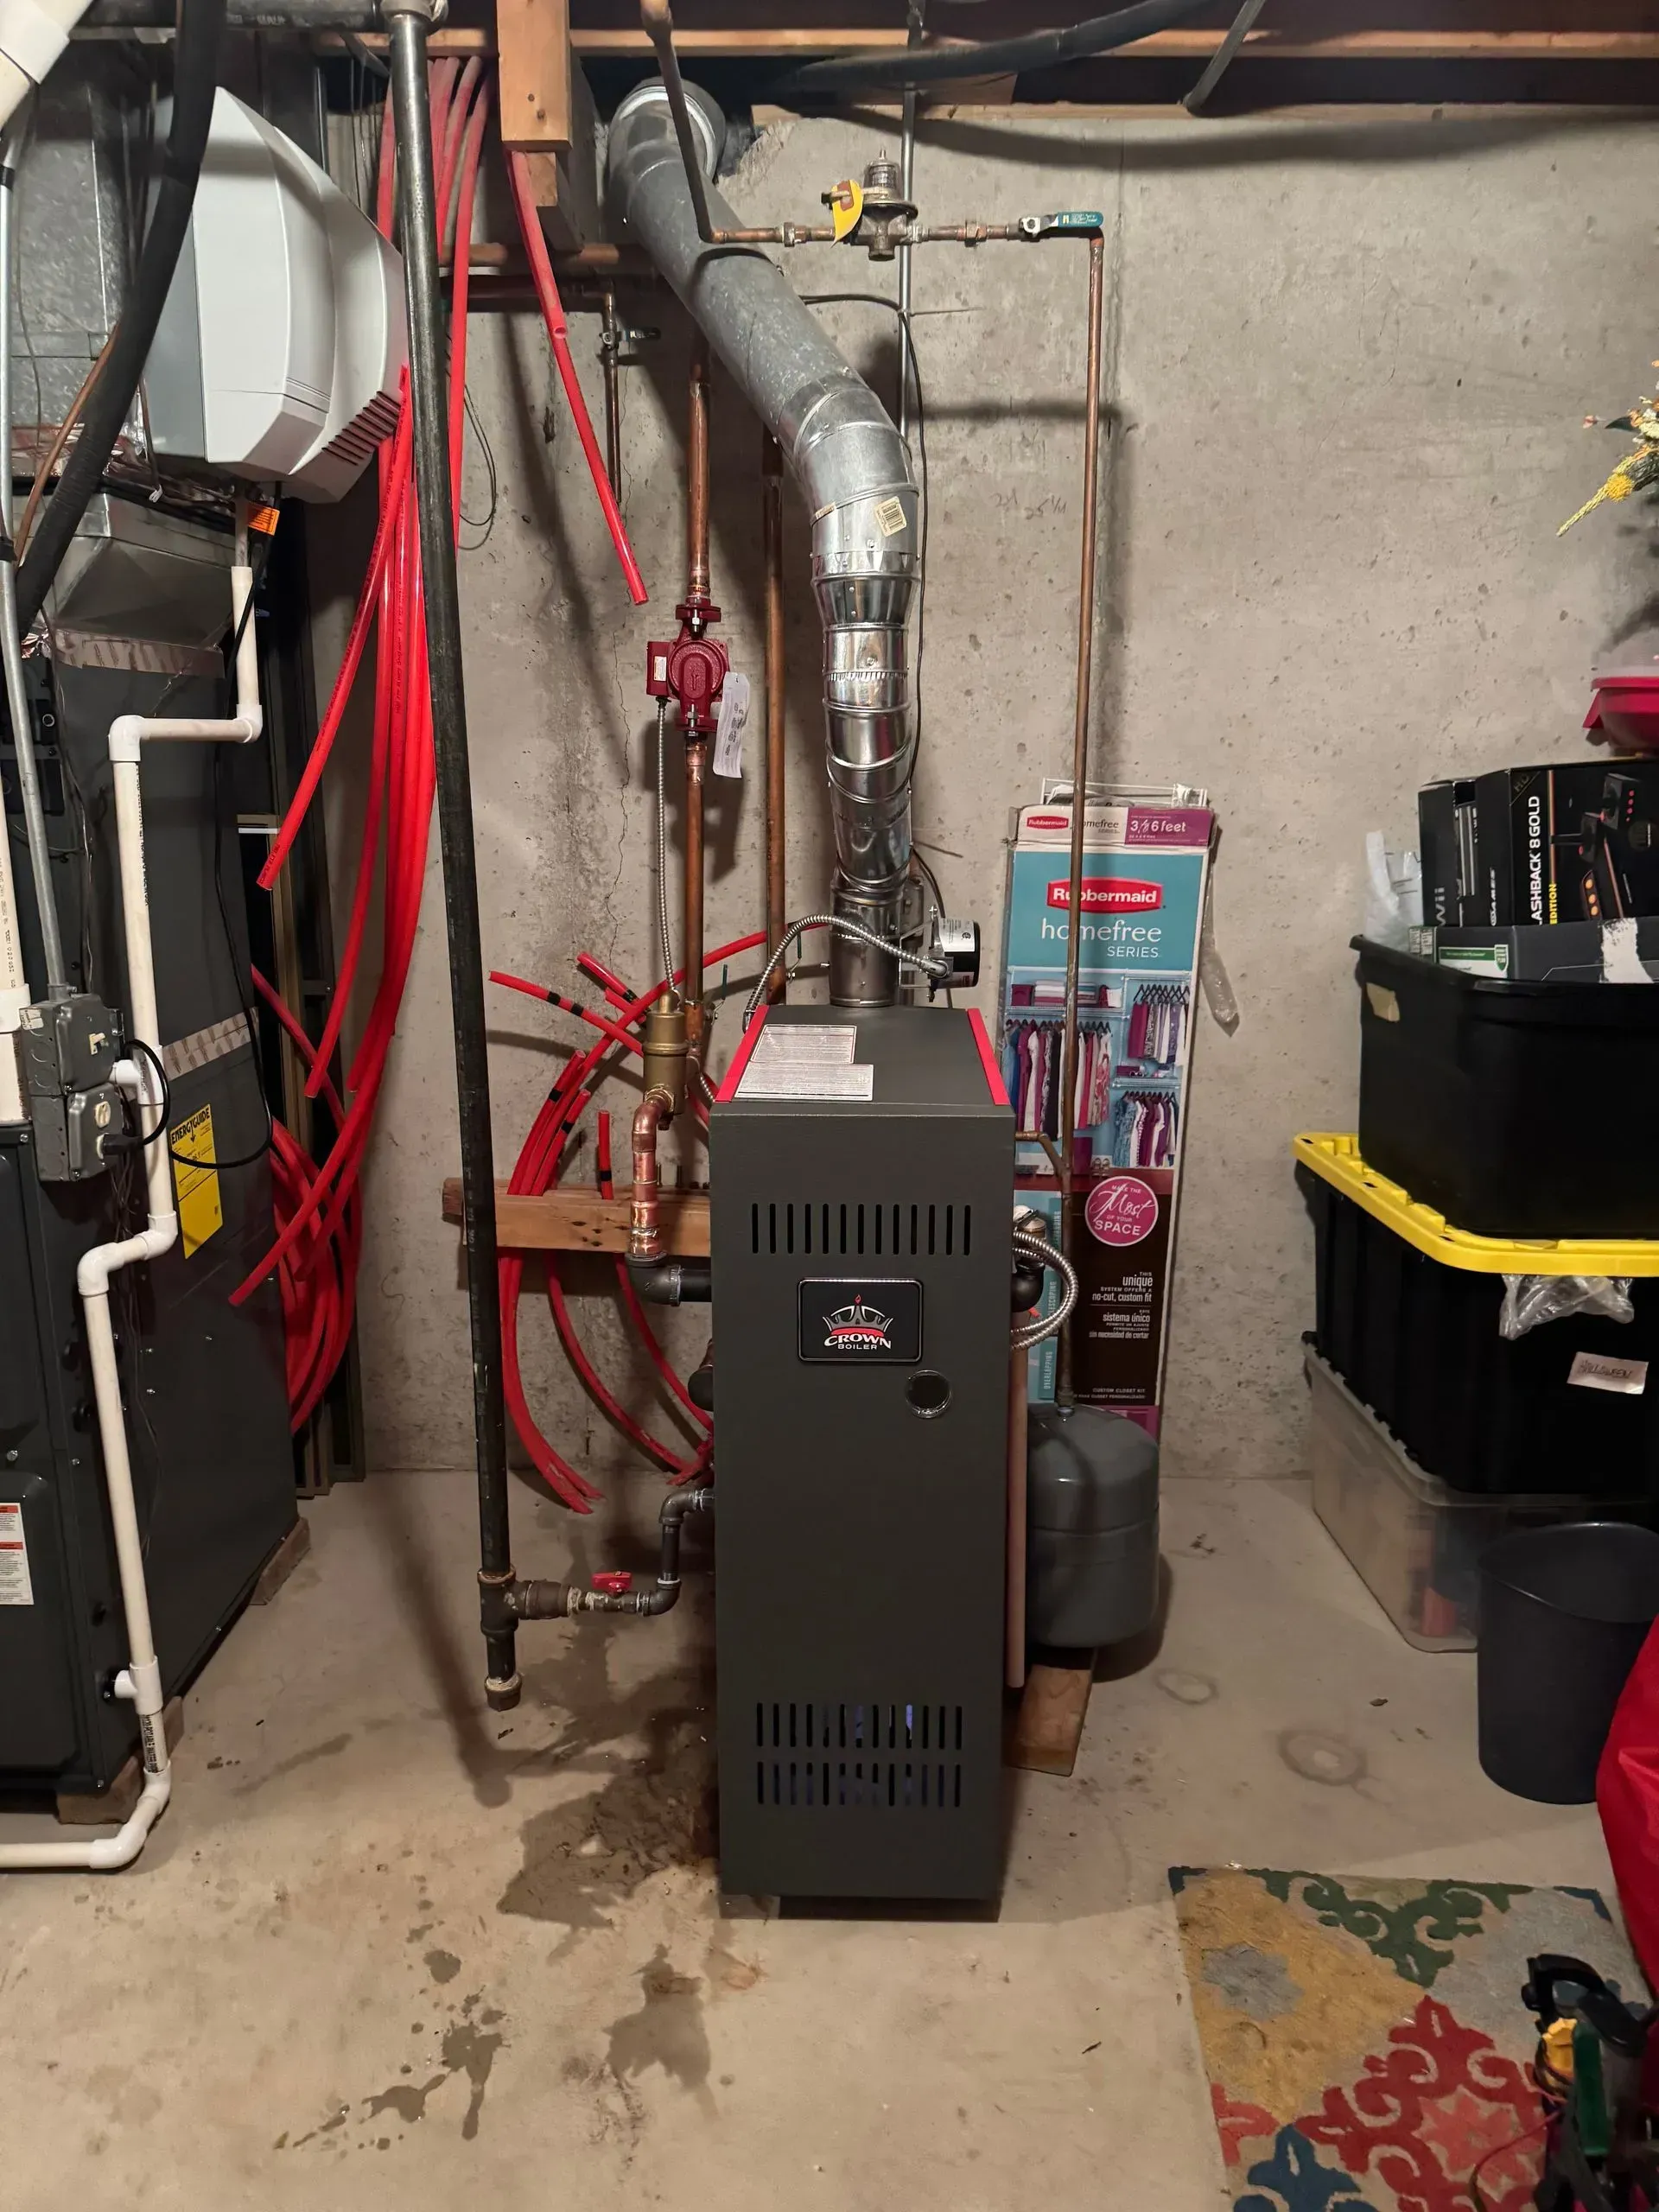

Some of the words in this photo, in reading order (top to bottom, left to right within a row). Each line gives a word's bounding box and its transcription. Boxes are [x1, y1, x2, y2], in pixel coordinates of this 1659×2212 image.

[1084, 818, 1119, 828] mefree
[1528, 796, 1541, 837] GOLD
[1130, 820, 1138, 831] 3
[1151, 820, 1159, 831] 6
[1160, 820, 1186, 832] feet
[1529, 838, 1541, 849] 8
[1529, 852, 1542, 925] ASHBACK
[1549, 883, 1558, 925] EDITION
[1041, 918, 1162, 943] homefree
[1107, 946, 1159, 958] SERIES
[1089, 1182, 1155, 1222] Most
[1094, 1219, 1141, 1236] SPACE
[1122, 1274, 1154, 1289] unique
[1092, 1293, 1116, 1302] no-cut,
[1117, 1294, 1143, 1302] custom
[1103, 1312, 1130, 1322] sistema
[1131, 1313, 1151, 1323] único
[823, 1333, 891, 1349] CROWN
[1043, 1351, 1053, 1389] OVERLAPPING
